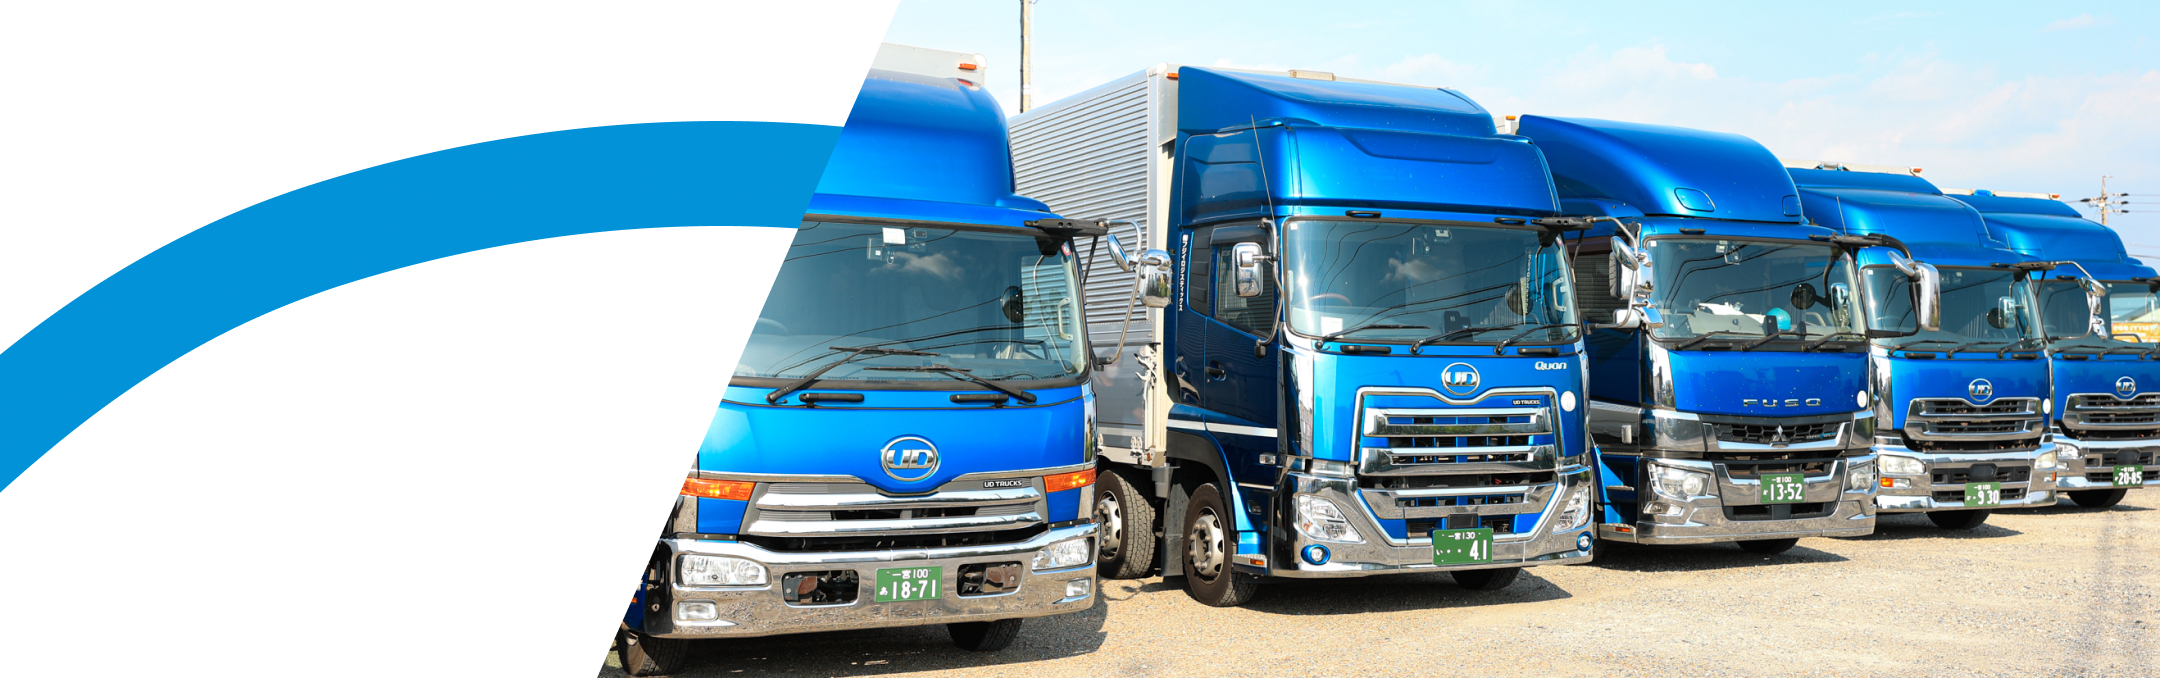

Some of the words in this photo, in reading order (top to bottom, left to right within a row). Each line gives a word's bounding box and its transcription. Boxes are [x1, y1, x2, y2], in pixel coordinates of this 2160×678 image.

[1535, 361, 1567, 370] Quon
[1743, 398, 1821, 408] FUSO
[2118, 471, 2142, 485] 20-85
[1770, 483, 1803, 501] 13-52
